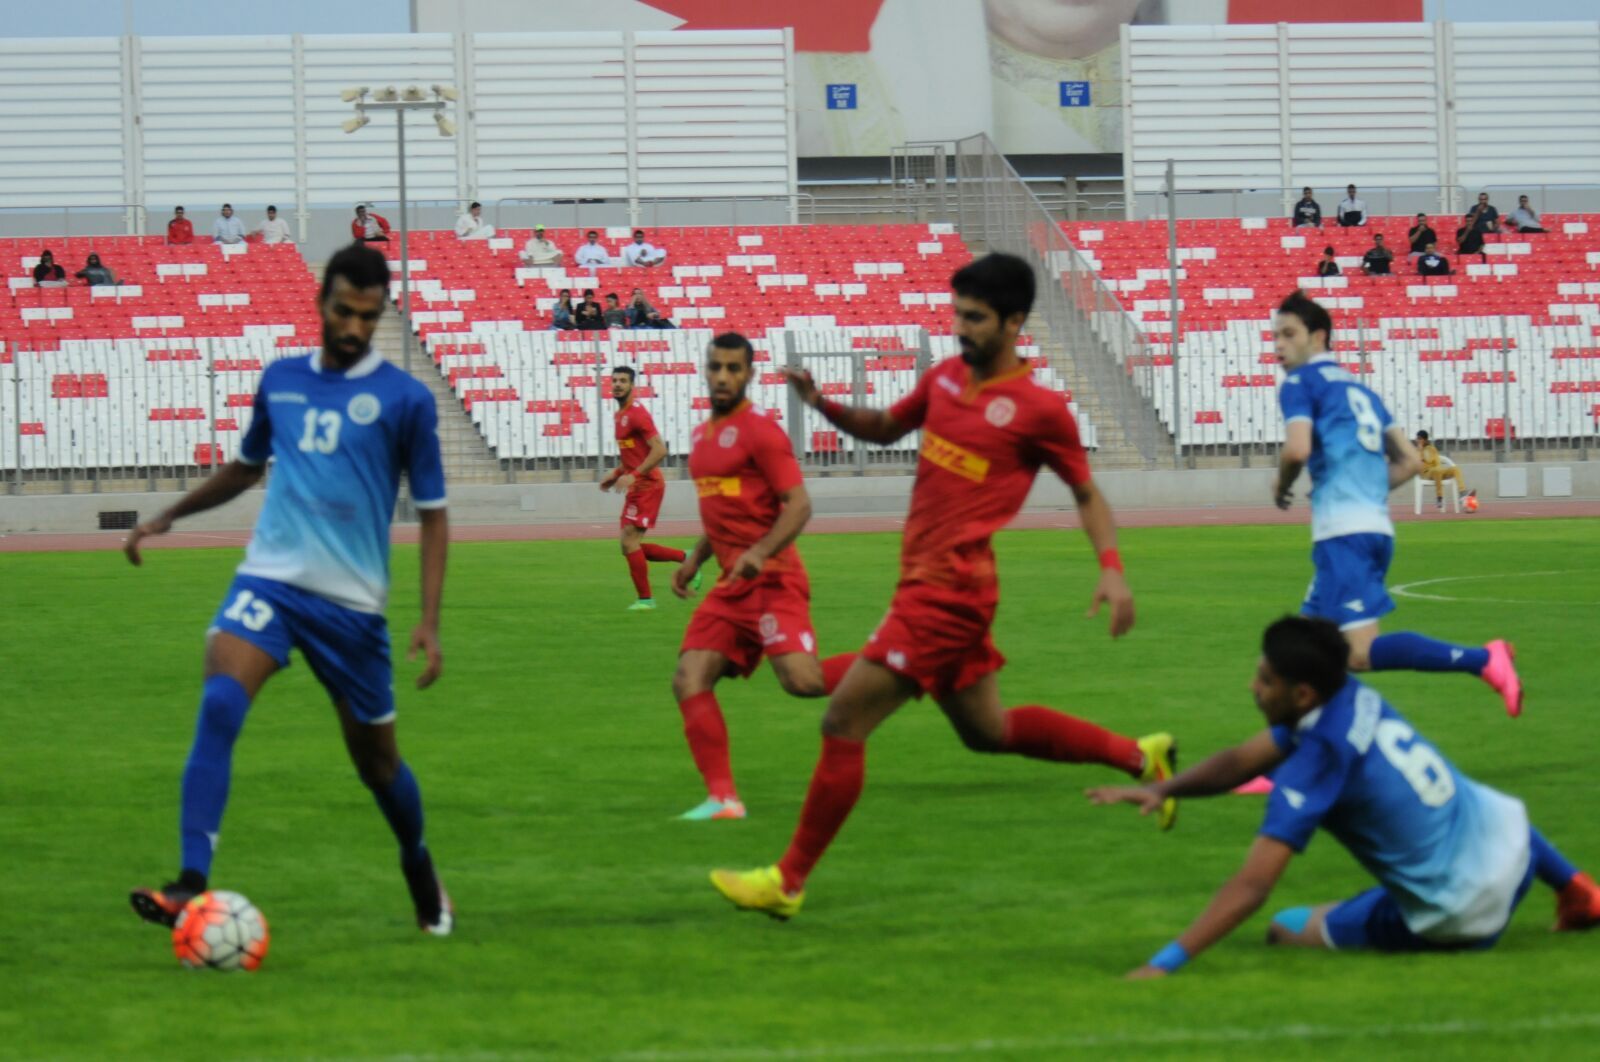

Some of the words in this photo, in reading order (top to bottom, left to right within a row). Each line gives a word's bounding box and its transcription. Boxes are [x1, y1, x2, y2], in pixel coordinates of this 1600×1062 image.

[298, 407, 342, 455] 13
[224, 589, 274, 632] 13
[1376, 718, 1456, 808] 6
